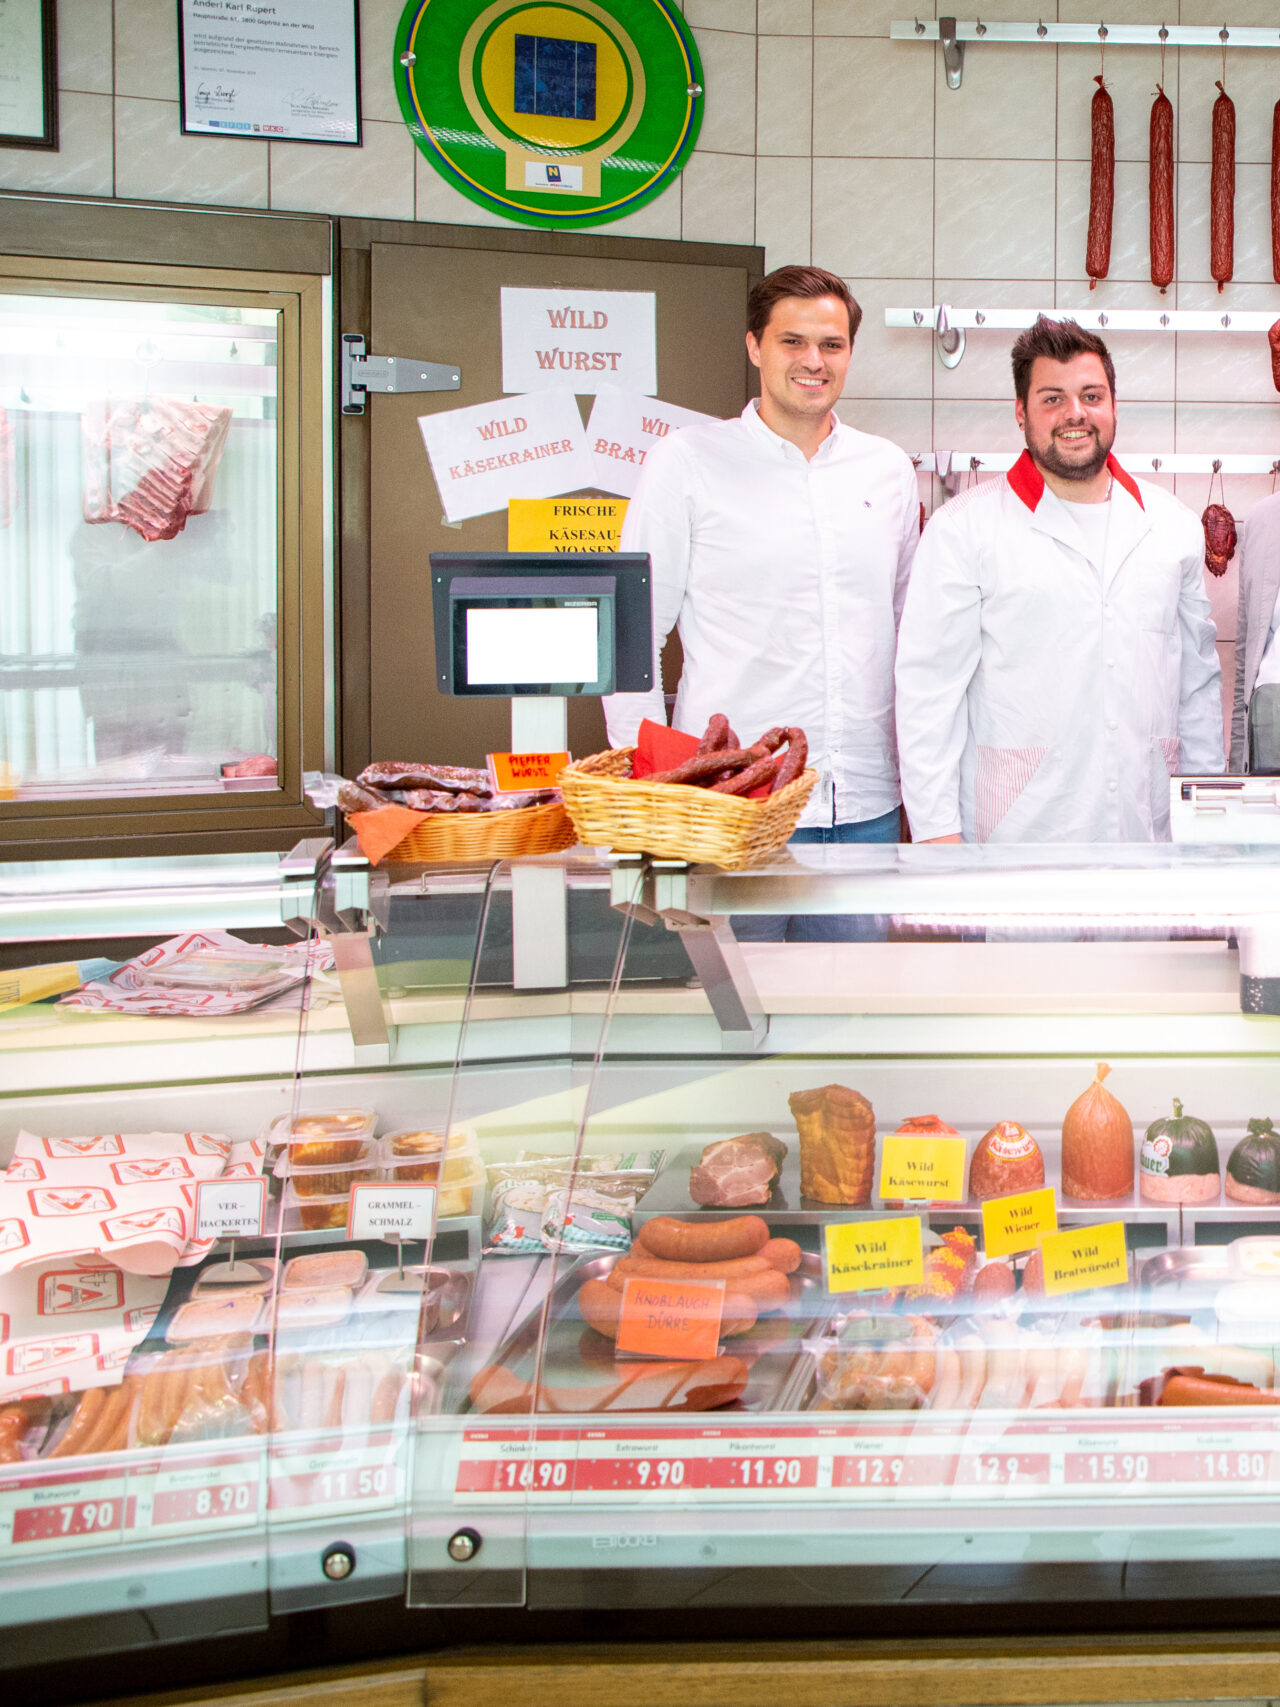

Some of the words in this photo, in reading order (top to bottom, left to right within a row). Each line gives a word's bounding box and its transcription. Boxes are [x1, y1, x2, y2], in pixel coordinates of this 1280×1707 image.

[225, 1, 244, 11] Karl
[246, 4, 277, 15] Rupert
[548, 166, 559, 177] N
[546, 306, 609, 330] WILD
[535, 347, 622, 371] WURST
[476, 417, 528, 441] WILD
[641, 416, 680, 437] WIL
[448, 439, 574, 480] KÄSEKRAINER
[553, 505, 617, 517] FRISCHE
[549, 528, 622, 541] KÄSESAU-
[906, 1160, 934, 1172] Wild
[888, 1175, 949, 1188] Käsewurst
[368, 1201, 415, 1210] GRAMMEL
[1009, 1206, 1033, 1219] Wild
[200, 1217, 259, 1228] HACKERTES
[369, 1218, 412, 1227] SCHMALZ
[1004, 1220, 1041, 1236] Wiener
[855, 1242, 887, 1254] Wild
[1072, 1247, 1099, 1259] Wild
[831, 1256, 914, 1275] Käsekrainer
[1053, 1258, 1121, 1281] Bratwürstel
[635, 1291, 709, 1310] KNOBLAUCH
[644, 1311, 690, 1331] DÜRRE
[637, 1461, 685, 1487] 9.90
[740, 1459, 802, 1485] 11.90
[857, 1459, 903, 1483] 12.9
[972, 1456, 1020, 1482] 12.9
[1087, 1455, 1149, 1480] 15.90
[1204, 1453, 1265, 1478] 14.80
[320, 1469, 388, 1499] 11.50
[195, 1485, 250, 1515] 8.90
[60, 1503, 114, 1533] 7.90
